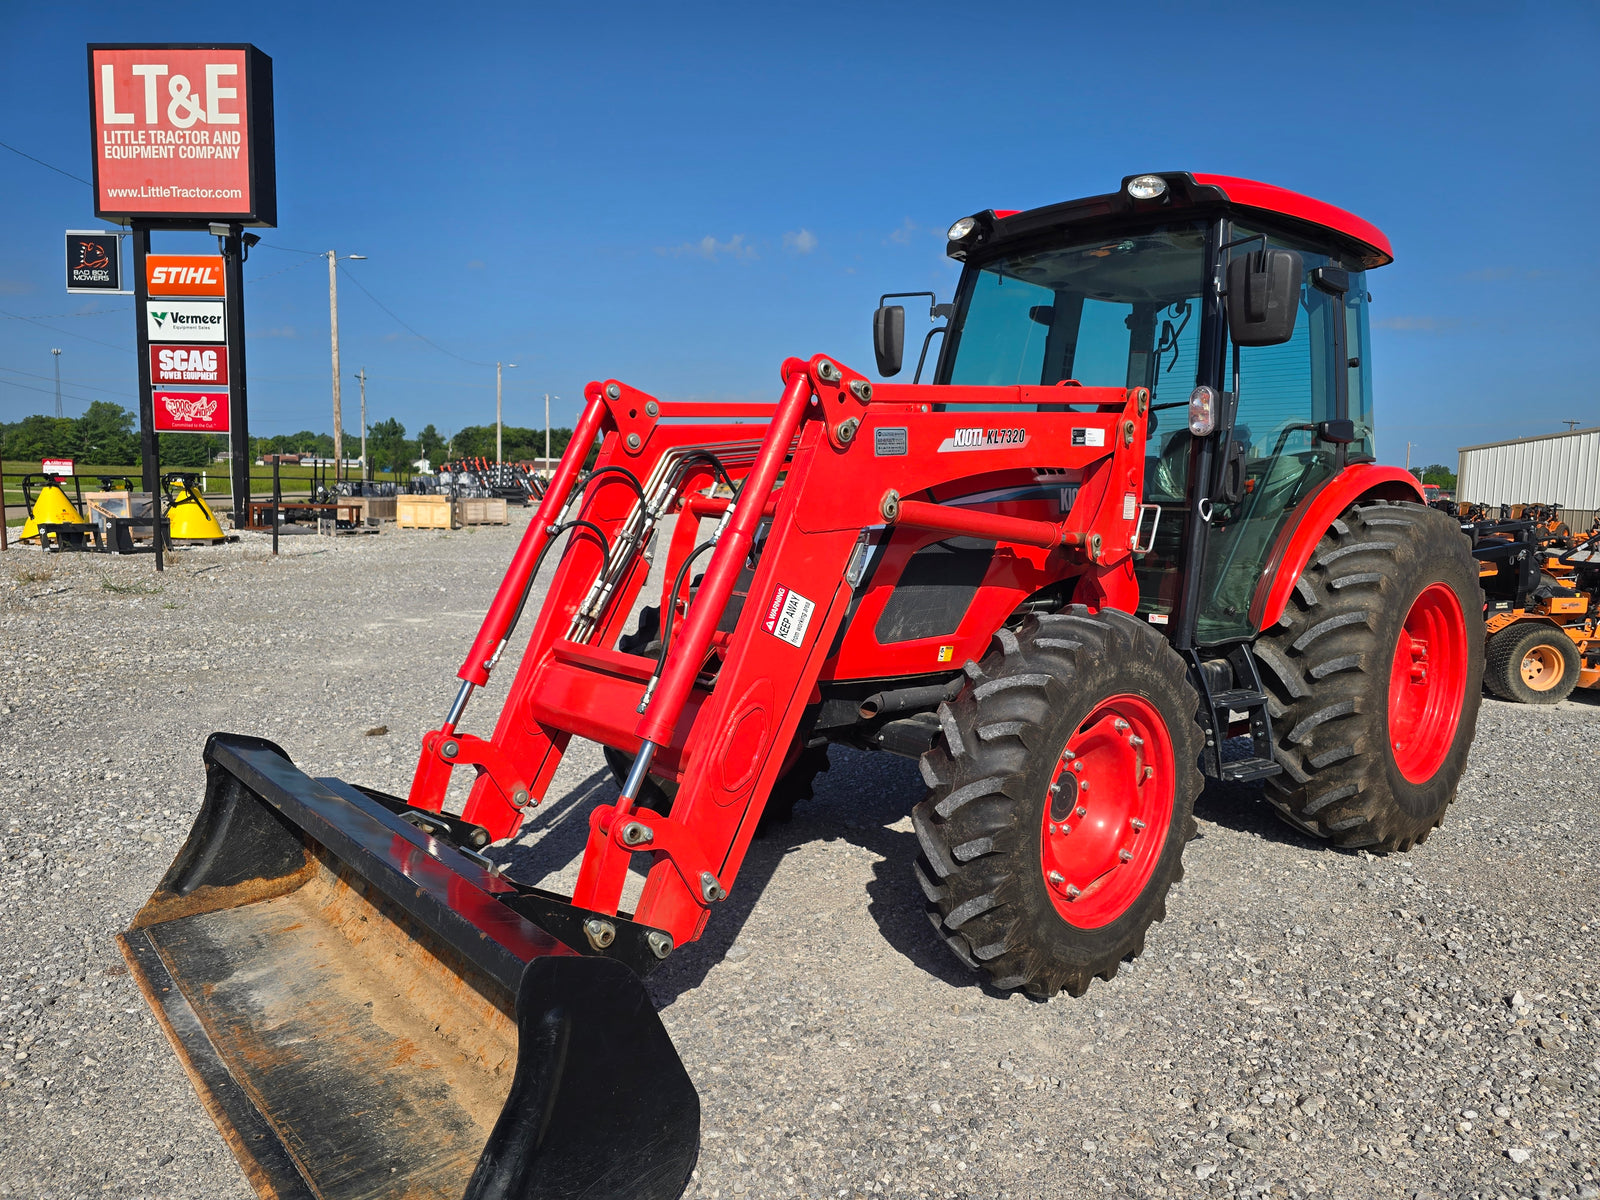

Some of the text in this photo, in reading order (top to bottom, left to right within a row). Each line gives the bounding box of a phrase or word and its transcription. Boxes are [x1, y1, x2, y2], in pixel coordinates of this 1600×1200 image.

[101, 64, 240, 128] LT&E
[103, 130, 241, 145] LITTLE TRACTOR AND
[104, 145, 241, 159] EQUIPMENT COMPANY
[107, 186, 242, 198] www.LittleTractor.com
[150, 266, 217, 284] STIHL
[170, 311, 222, 324] Vermeer
[158, 349, 218, 371] SCAG
[160, 371, 218, 381] POWER EQUIPMENT
[953, 428, 1025, 447] KIOTI KL7320
[768, 587, 786, 620] WARNING
[778, 594, 800, 639] KEEP AWAY
[791, 601, 811, 643] from working area
